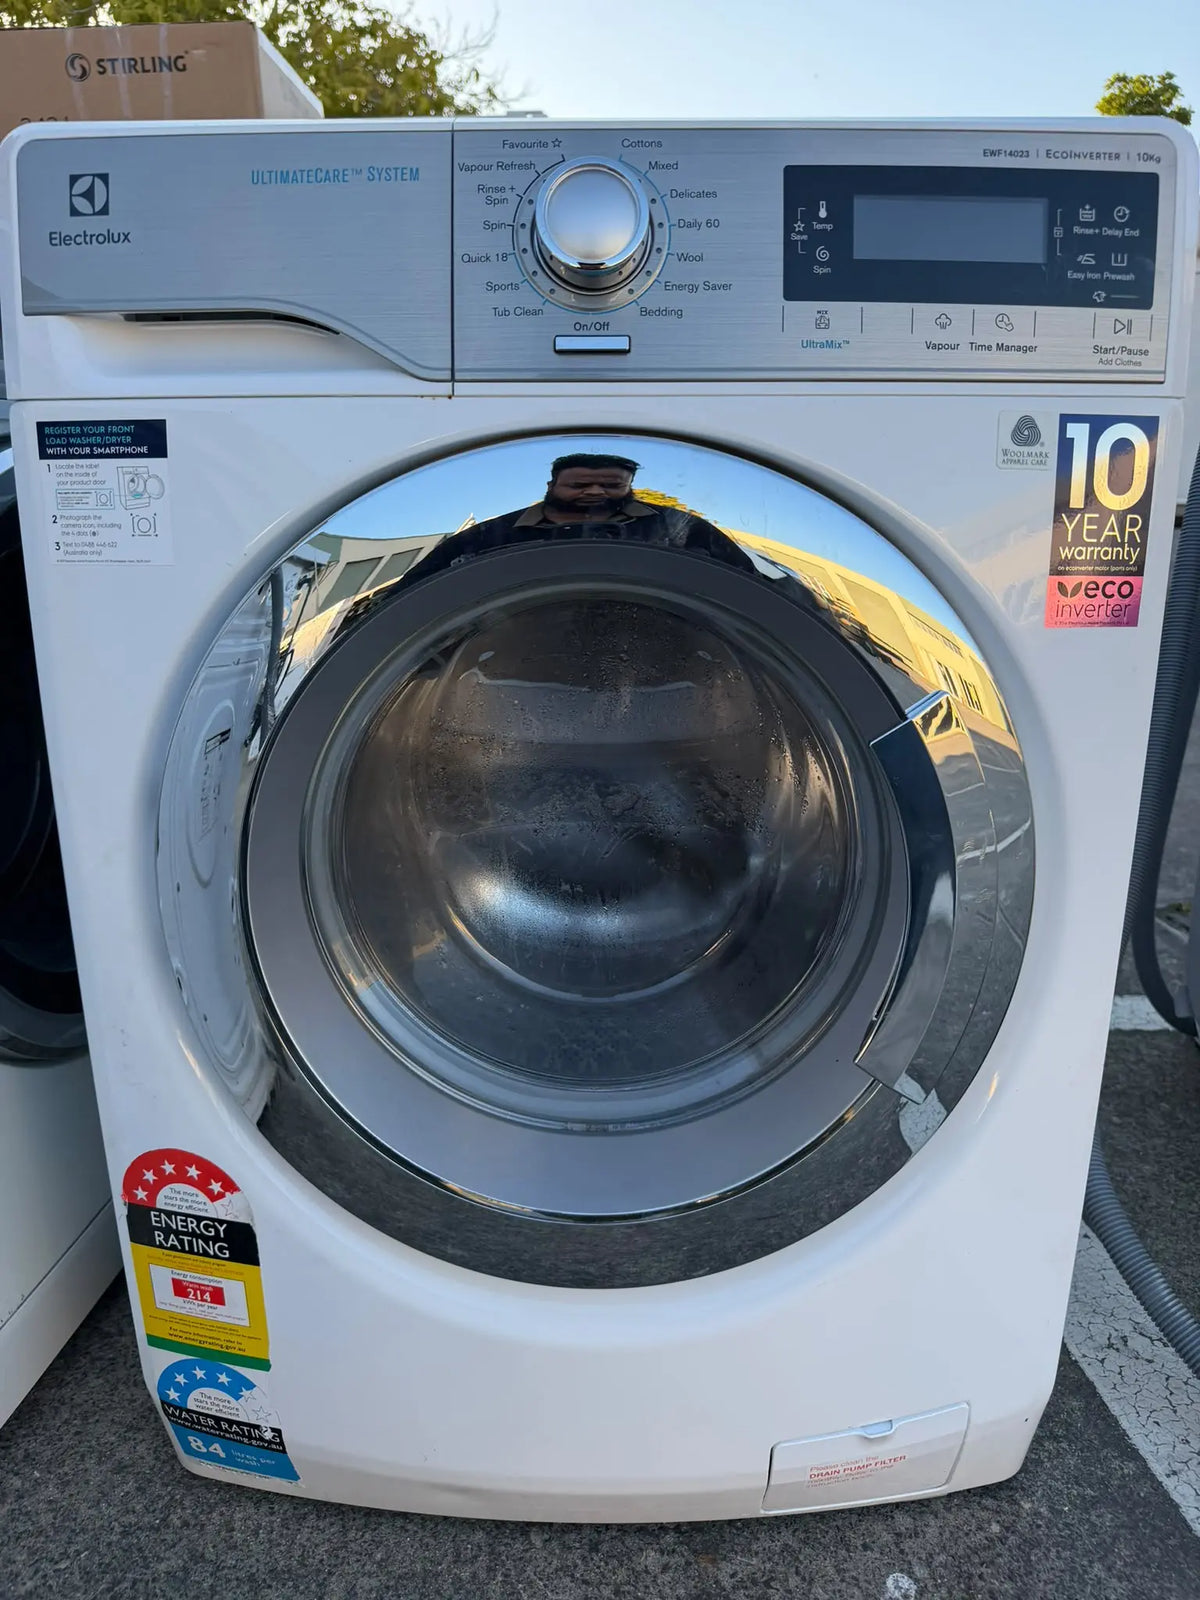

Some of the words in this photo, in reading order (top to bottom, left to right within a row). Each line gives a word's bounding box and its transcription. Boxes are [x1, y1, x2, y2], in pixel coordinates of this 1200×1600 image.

[96, 55, 187, 75] STIRLING
[502, 139, 549, 149] Favourite
[621, 138, 663, 148] Cottons
[982, 149, 1030, 158] EWF14023
[458, 162, 495, 173] Vapour
[496, 161, 536, 171] Refresh
[648, 161, 679, 170] Mixed
[477, 184, 506, 194] Rinse
[670, 189, 718, 199] Delicates
[485, 195, 509, 207] Spin
[483, 220, 507, 231] Spin
[677, 219, 703, 230] Daily
[705, 219, 720, 228] 60
[812, 222, 834, 232] Temp
[1073, 226, 1100, 235] Rinse+
[1102, 227, 1123, 238] Delay
[1124, 228, 1140, 237] End
[49, 229, 131, 247] Electrolux
[790, 232, 808, 241] Save
[461, 253, 492, 264] Quick
[495, 253, 508, 263] 18
[676, 253, 704, 262] Wool
[813, 265, 832, 276] Spin
[1068, 270, 1085, 280] Easy
[1087, 271, 1100, 279] Iron
[1104, 272, 1135, 280] Prewash
[485, 282, 520, 293] Sports
[664, 282, 699, 293] Energy
[704, 282, 733, 292] Saver
[493, 307, 512, 317] Tub
[515, 307, 543, 316] Clean
[640, 307, 683, 319] Bedding
[573, 322, 610, 332] On/Off
[925, 341, 960, 351] Vapour
[969, 342, 992, 352] Time
[996, 342, 1038, 353] Manager
[1092, 345, 1150, 356] Start/Pause
[1098, 357, 1112, 366] Add
[1114, 358, 1142, 367] Clothes
[44, 426, 81, 435] REGISTER
[83, 426, 106, 434] YOUR
[108, 425, 134, 434] FRONT
[46, 436, 67, 445] LOAD
[69, 436, 132, 445] WASHER/DRYER
[68, 446, 91, 454] YOUR
[93, 446, 148, 454] SMARTPHONE
[1001, 448, 1050, 458] WOOLMARK
[1002, 458, 1029, 466] APPAREL
[1066, 422, 1151, 511] 10
[52, 514, 58, 524] 2
[1062, 513, 1142, 543] YEAR
[55, 542, 60, 550] 3
[1059, 543, 1140, 565] warranty
[1084, 580, 1134, 600] eco
[1056, 600, 1132, 618] inverter
[150, 1211, 228, 1238] ENERGY
[154, 1230, 230, 1258] RATING
[186, 1288, 211, 1302] 214
[200, 1392, 212, 1400] The
[213, 1395, 232, 1404] more
[194, 1397, 209, 1406] stars
[210, 1400, 222, 1408] the
[222, 1404, 240, 1412] more
[195, 1404, 214, 1412] water
[163, 1404, 218, 1428] WATER
[222, 1422, 280, 1442] RATING
[188, 1436, 226, 1458] 84
[810, 1469, 840, 1480] DRAIN
[842, 1463, 872, 1473] PUMP
[874, 1455, 906, 1467] FILTER
